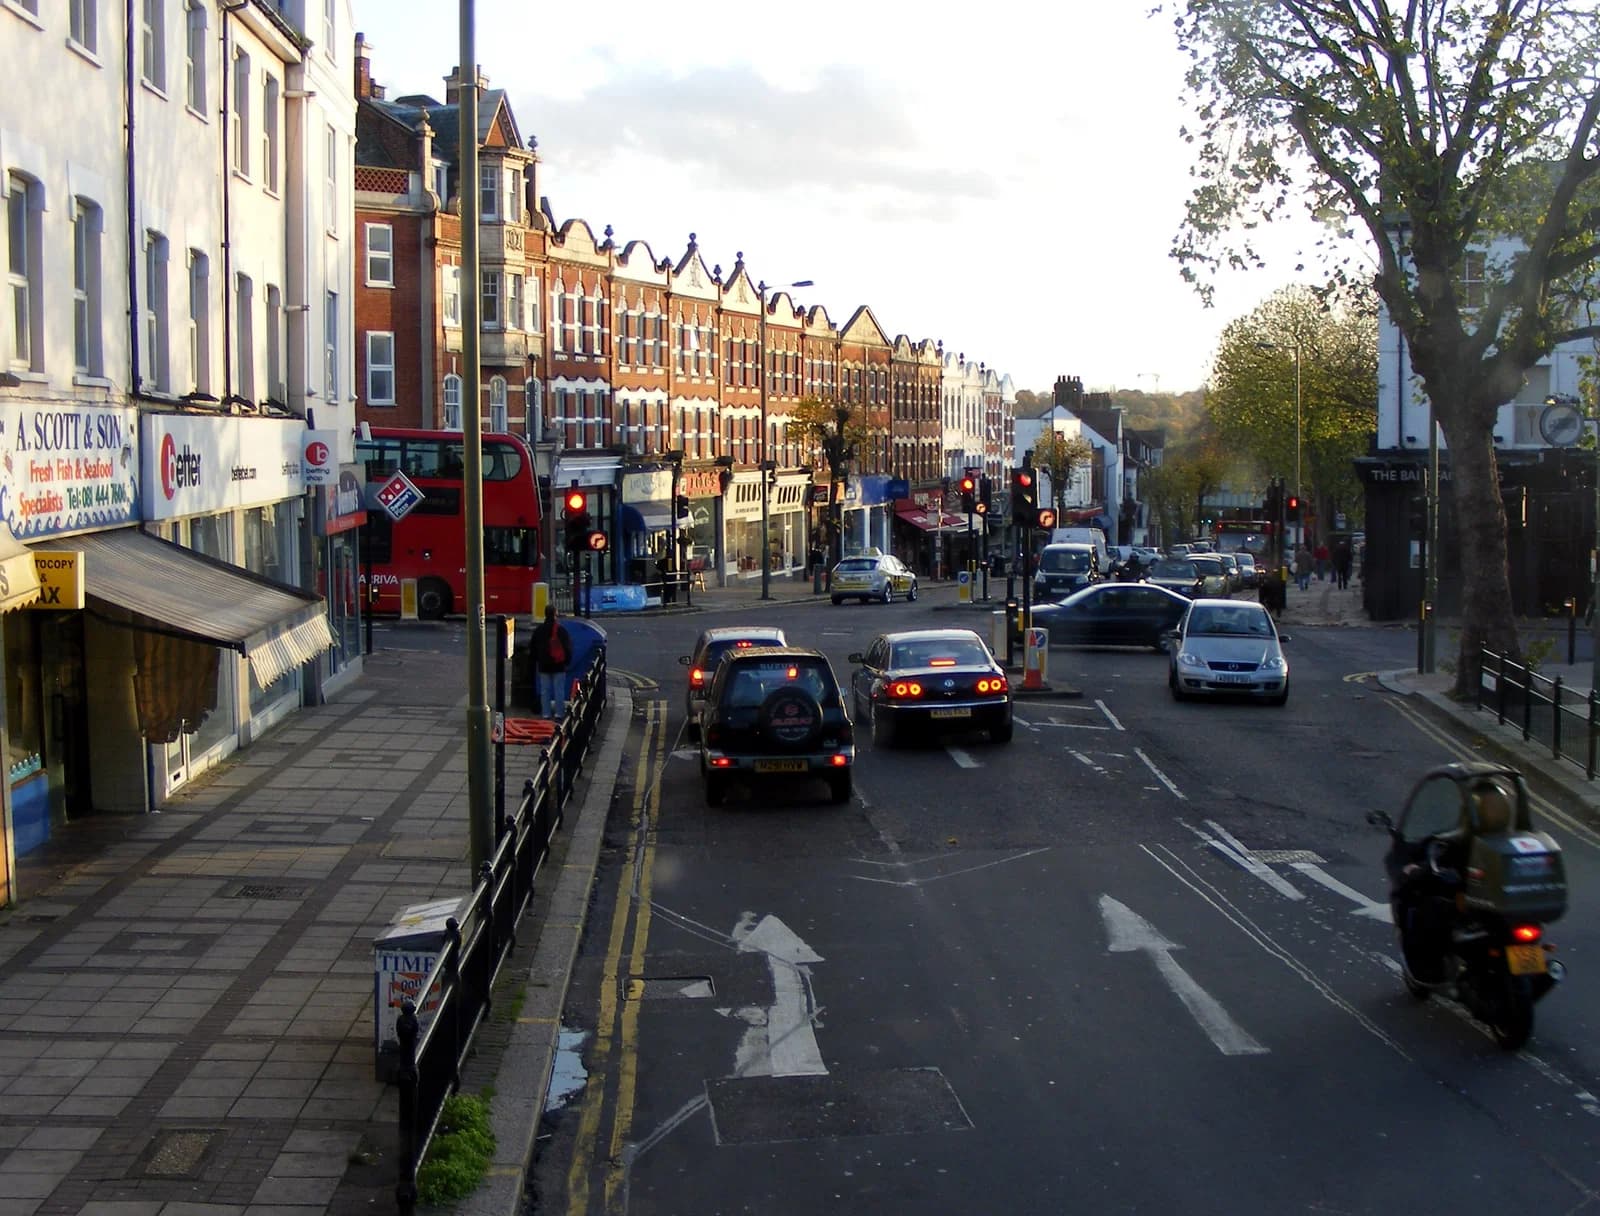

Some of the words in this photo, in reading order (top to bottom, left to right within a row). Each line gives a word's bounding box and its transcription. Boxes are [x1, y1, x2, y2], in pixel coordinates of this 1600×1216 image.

[16, 411, 31, 451] A.
[34, 412, 81, 450] SCOTT
[84, 413, 94, 450] &
[96, 414, 121, 449] SON
[29, 459, 54, 482] Fresh
[56, 458, 73, 480] Fish
[75, 457, 83, 479] &
[84, 456, 114, 479] Seafood
[167, 443, 201, 489] better
[1371, 470, 1398, 481] THE
[19, 489, 64, 519] Specialists
[96, 483, 110, 507] 444
[359, 574, 399, 584] ARIVA
[40, 586, 61, 604] AX
[381, 956, 436, 973] TIME
